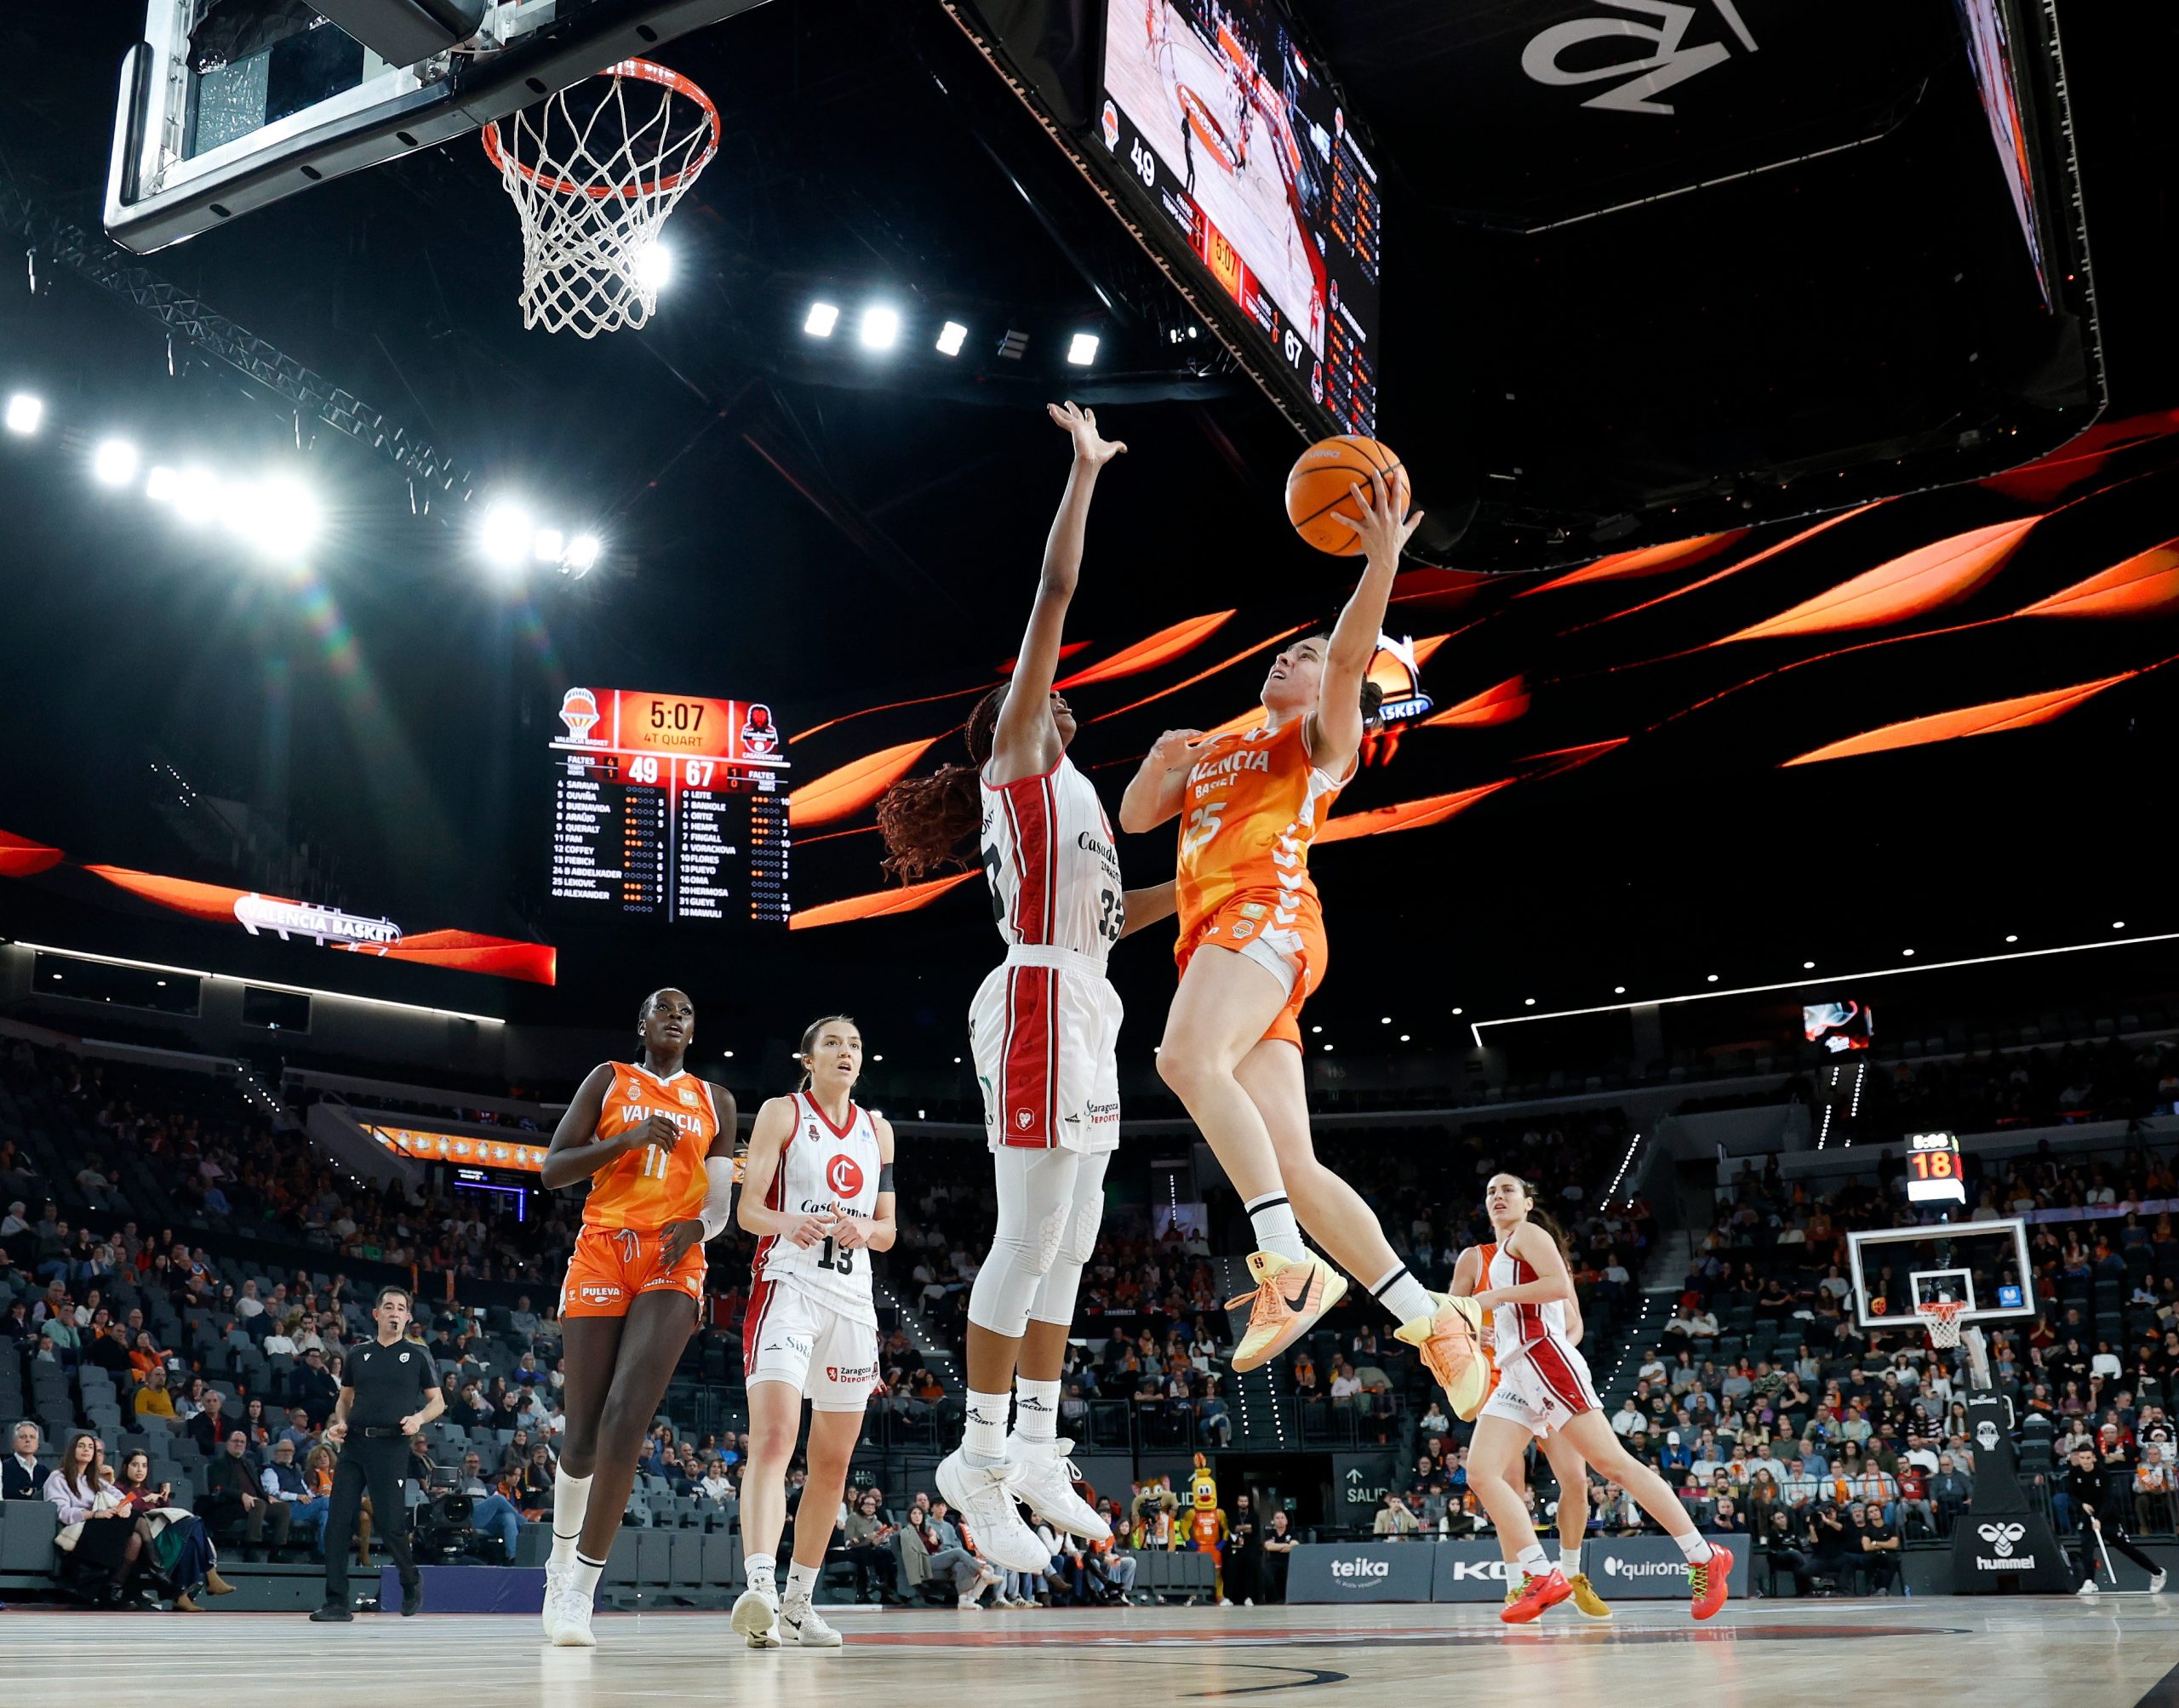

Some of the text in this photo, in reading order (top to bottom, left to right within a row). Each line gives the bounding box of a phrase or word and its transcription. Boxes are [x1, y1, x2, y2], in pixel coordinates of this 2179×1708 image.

[1130, 137, 1155, 187] 49
[1215, 234, 1237, 277] 5:07
[1284, 328, 1303, 370] 67
[651, 701, 705, 731] 5:07
[1377, 701, 1422, 722] SKET
[555, 736, 585, 745] VALENCIA
[644, 733, 704, 747] 4T QUART
[568, 755, 596, 765] FALTES
[742, 752, 784, 762] CASADEMONT
[608, 769, 613, 778] 1
[629, 757, 658, 783] 49
[686, 760, 714, 787] 67
[731, 768, 775, 780] 1 FALTES
[1186, 751, 1270, 790] ALENCIA
[558, 780, 600, 791] 4 SARAVIA
[730, 780, 738, 788] 0
[566, 791, 597, 801] OUVIÑA
[658, 798, 664, 807] 5
[683, 790, 791, 806] 0 LEITE 10
[557, 801, 664, 818] 6 BUENAVIDA 6
[690, 802, 726, 812] BANKOLE
[556, 812, 563, 820] 8
[657, 820, 664, 828] 5
[683, 811, 788, 827] 4 ORTIZ 2
[556, 822, 601, 834] 9 QUERALT
[683, 822, 788, 837] 5 HEMPE 7
[564, 834, 583, 843] FAM
[657, 841, 663, 849] 4
[690, 833, 722, 843] FINGALL
[781, 840, 791, 848] 10
[1078, 831, 1119, 865] Casade
[553, 844, 663, 860] 12 COFFEY 5
[682, 843, 689, 852] 8
[690, 844, 736, 855] VORACKOVA
[553, 855, 663, 871] 13 FIEBICH 6
[680, 854, 690, 862] 10
[690, 854, 719, 864] FLORES
[552, 866, 663, 882] 24 B ABDELKADER 5
[680, 865, 789, 880] 13 PUEYO 9
[1101, 861, 1123, 885] ZARAGOZ
[552, 877, 663, 893] 25 LEKOVIC 6
[690, 877, 709, 885] OMA
[552, 888, 662, 904] 40 ALEXANDER 7
[679, 886, 788, 901] 20 HERMOSA 2
[679, 897, 791, 912] 31 GUEYE 16
[689, 909, 722, 918] MAWULI
[782, 914, 788, 923] 7
[1099, 888, 1125, 942] 33
[247, 905, 394, 944] VALENCIA BASKET
[644, 1143, 670, 1180] 11
[1912, 1151, 1952, 1179] 18
[818, 1236, 854, 1276] 13
[582, 1287, 621, 1297] PULEVA
[841, 1367, 872, 1376] Zaragoza
[1496, 1392, 1529, 1406] silke
[1017, 1402, 1054, 1413] RCURY
[967, 1414, 998, 1426] CURY
[1330, 1557, 1389, 1577] teika
[1976, 1555, 2035, 1570] hummel
[1621, 1561, 1690, 1581] quiróns
